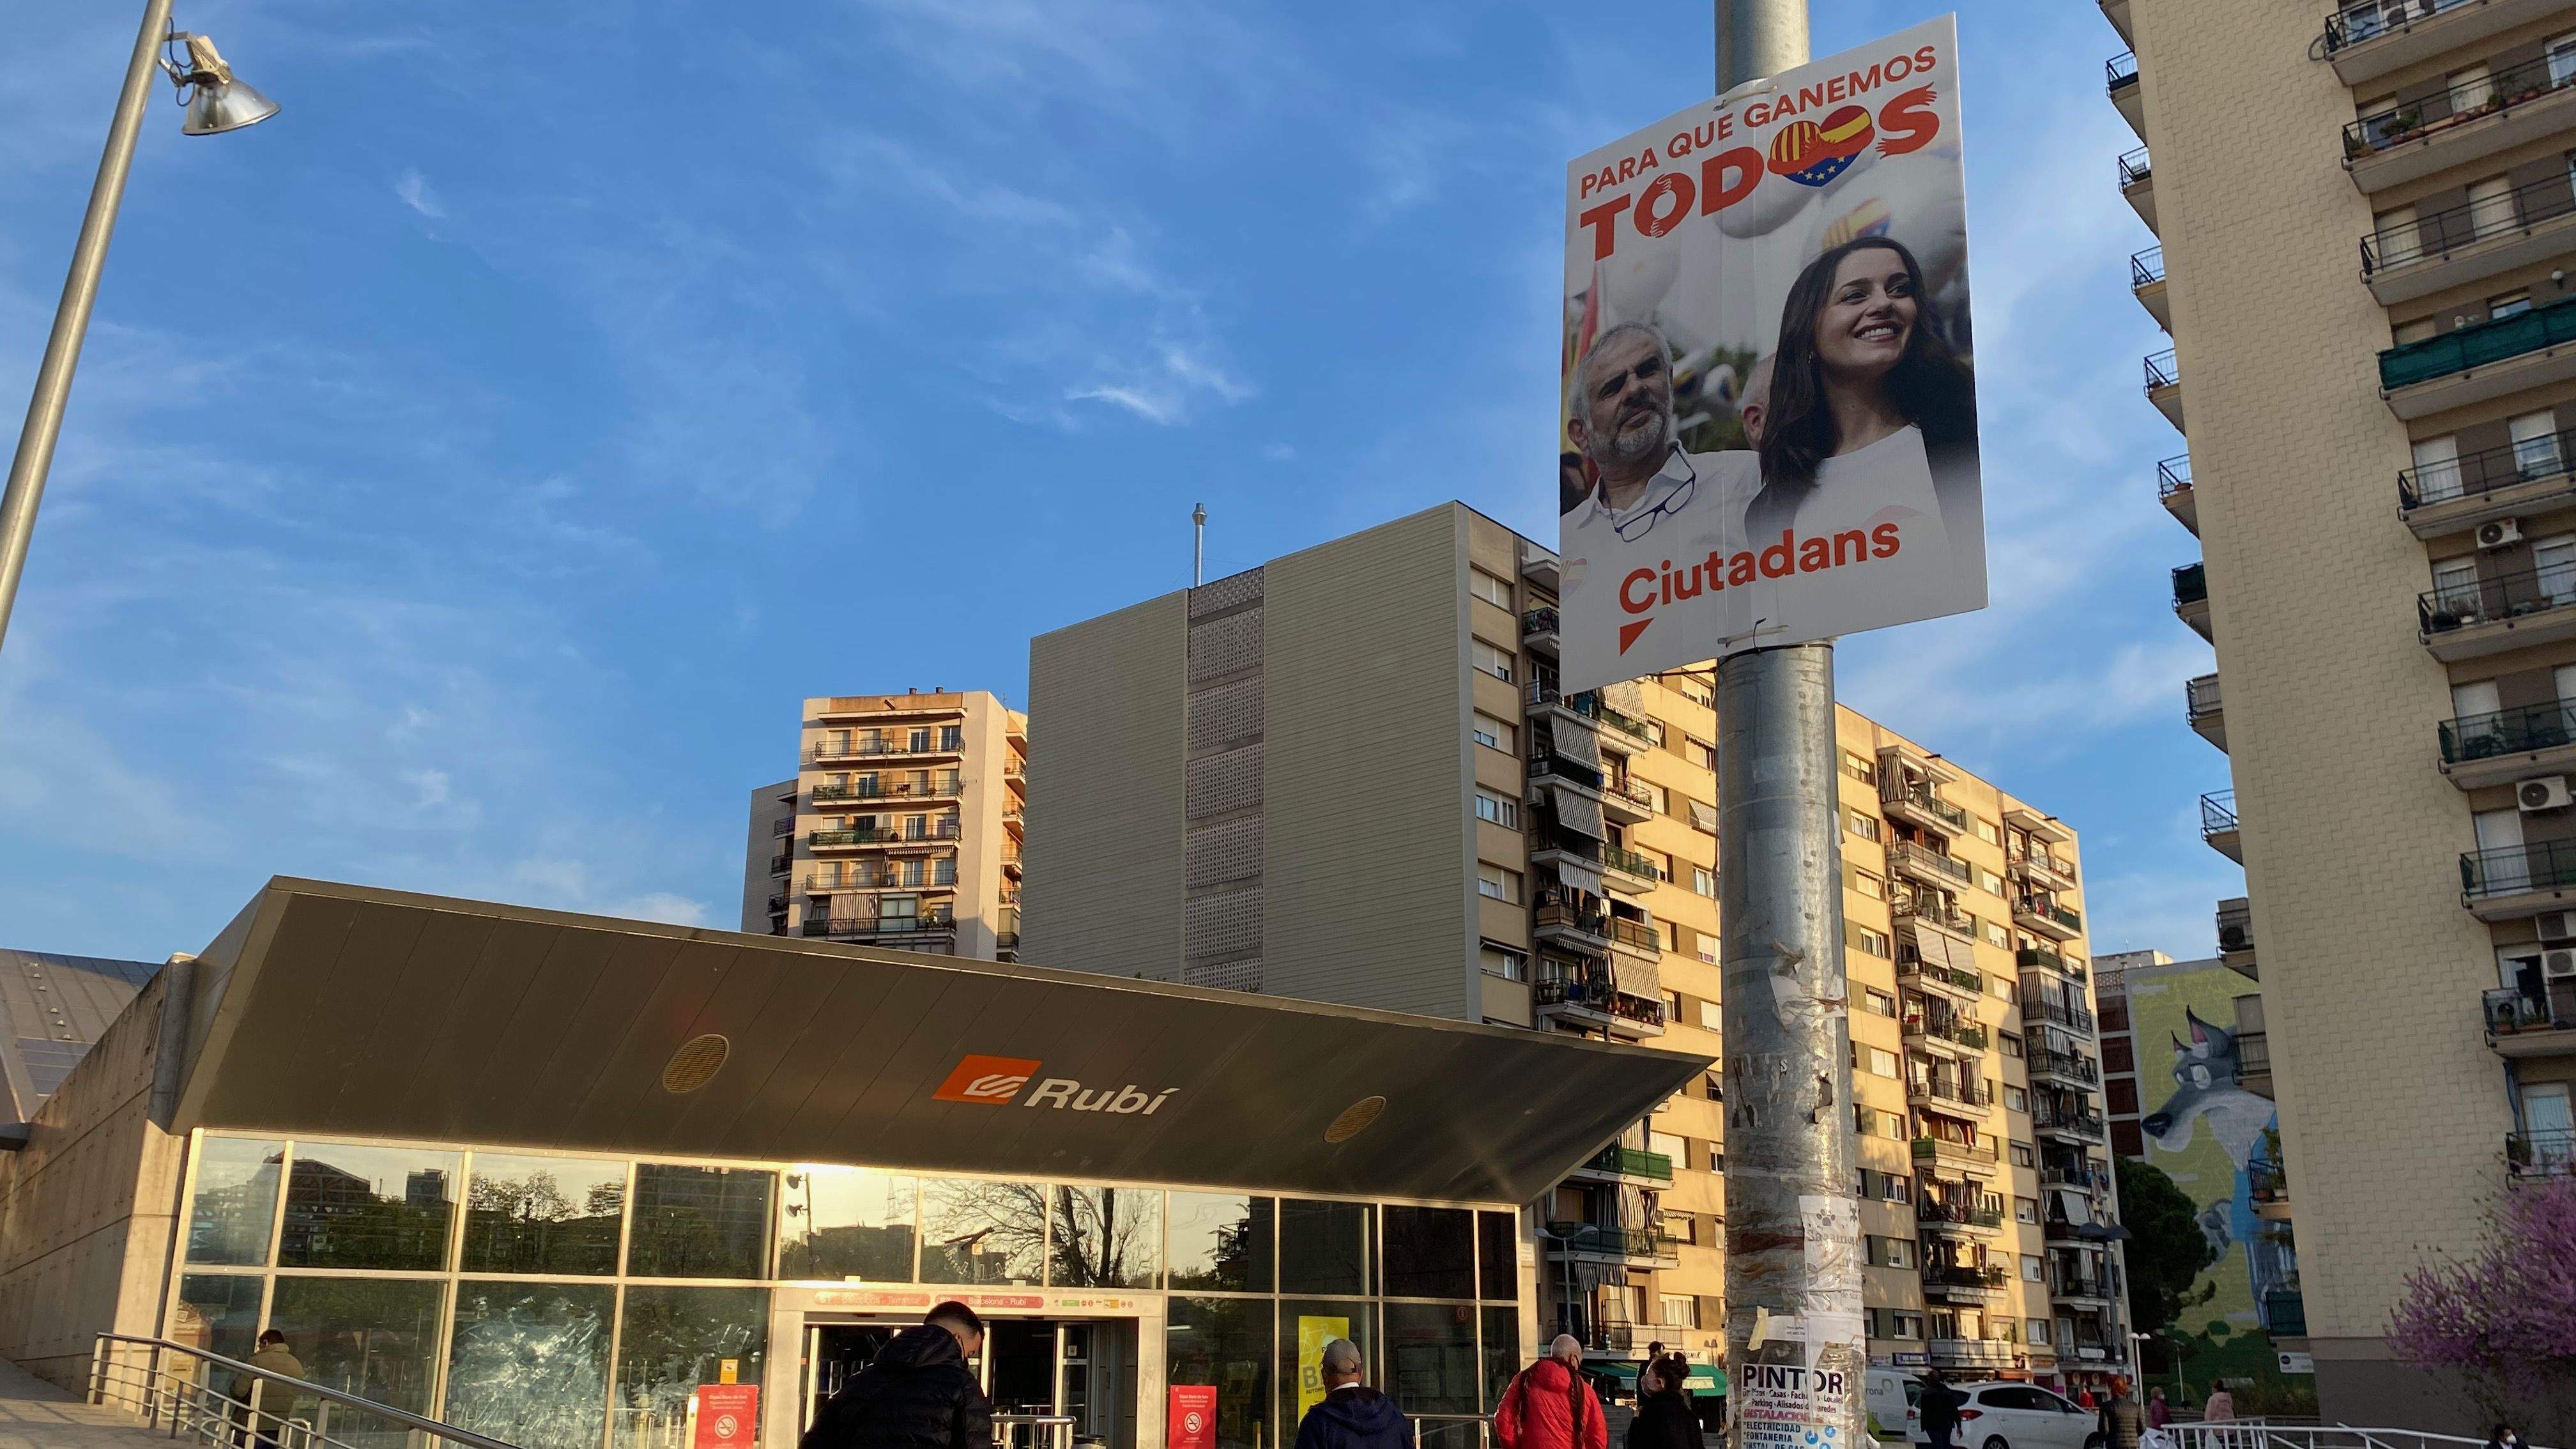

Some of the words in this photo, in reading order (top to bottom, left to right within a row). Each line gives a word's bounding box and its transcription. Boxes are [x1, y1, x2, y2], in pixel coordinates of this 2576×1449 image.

[1581, 147, 1659, 199] PARA
[1667, 113, 1733, 158] QUE
[1744, 45, 1936, 129] GANEMOS
[1619, 522, 1900, 615] Ciutadans
[1023, 1078, 1181, 1115] Rubí
[968, 1296, 1004, 1305] Barcelona
[1743, 1365, 1843, 1395] PINTOR
[1769, 1389, 1787, 1398] Casas
[1751, 1398, 1773, 1409] Parking
[1776, 1399, 1804, 1410] Alisados
